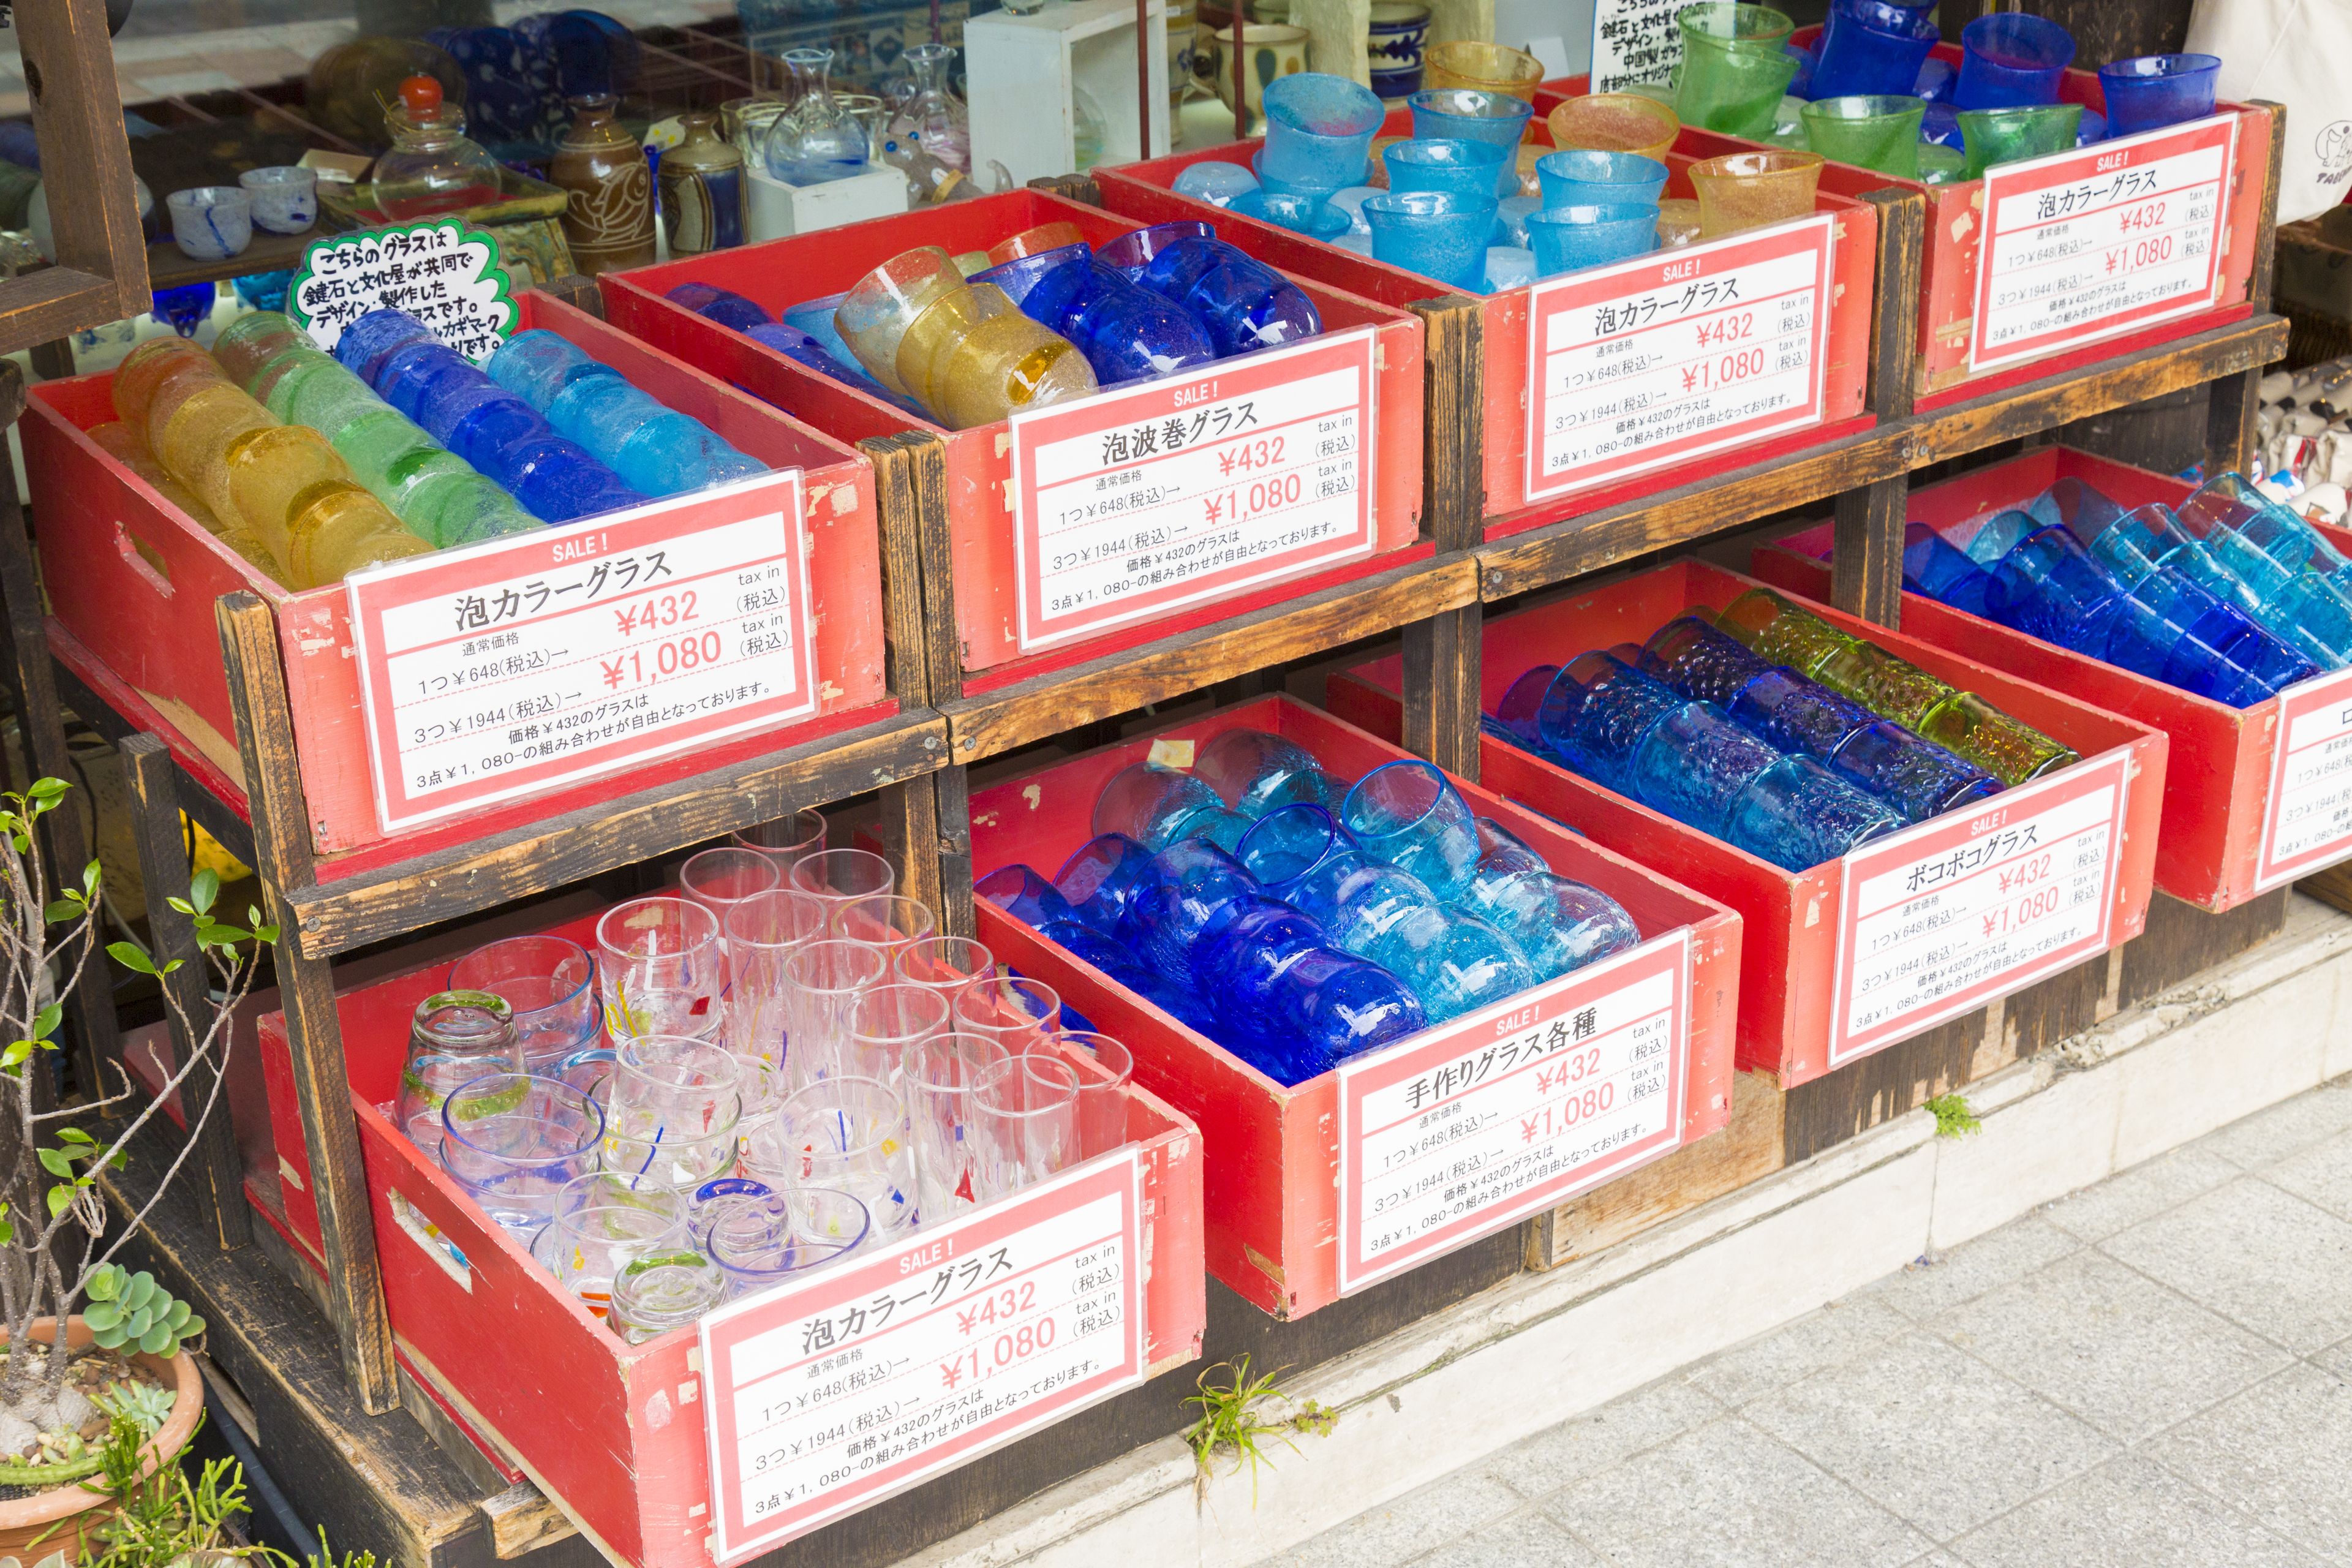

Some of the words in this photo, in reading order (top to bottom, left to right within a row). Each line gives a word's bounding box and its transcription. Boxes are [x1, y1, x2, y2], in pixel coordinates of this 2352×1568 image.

[320, 232, 447, 274] こちらのグラスは
[303, 252, 474, 307] 鍵石と文化屋が共同で
[1663, 258, 1700, 282] SALE!
[1595, 277, 1739, 337] 泡カラーグラス
[1781, 300, 1796, 311] tax
[1800, 293, 1809, 306] in
[1696, 312, 1753, 348] ¥432
[1777, 312, 1810, 333] (税込)
[1596, 339, 1633, 358] 通常価格
[1779, 341, 1794, 352] tax
[1798, 335, 1806, 347] in
[1682, 347, 1764, 393] ¥1,080
[1775, 350, 1808, 371] (税込)
[1174, 381, 1218, 407] SALE!
[1102, 401, 1258, 466] 泡波巻グラス
[1318, 421, 1337, 433] tax
[1342, 414, 1352, 427] in
[1218, 435, 1285, 477] ¥432
[1315, 434, 1355, 458] (税込)
[1096, 469, 1142, 491] 通常価格
[1318, 465, 1337, 477] tax
[1342, 458, 1352, 471] in
[1204, 473, 1301, 525] ¥1,080
[1316, 475, 1355, 498] (税込)
[552, 533, 608, 562] SALE!
[737, 572, 761, 586] tax
[767, 565, 780, 579] in
[454, 551, 672, 632] 泡カラーグラス
[737, 586, 785, 613] (税込)
[614, 590, 699, 636] ¥432
[742, 620, 765, 633] tax
[771, 612, 783, 627] in
[462, 631, 519, 657] 通常価格
[740, 630, 788, 657] (税込)
[600, 631, 721, 690] ¥1,080
[1971, 809, 2007, 836] SALE!
[2078, 836, 2092, 848] tax
[2095, 829, 2105, 840] in
[1906, 824, 2037, 892] ボコボコグラス
[2073, 846, 2105, 869] (税込)
[1999, 853, 2051, 894] ¥432
[2073, 876, 2087, 887] tax
[2091, 869, 2100, 880] in
[1902, 895, 1939, 917] 通常価格
[2069, 883, 2100, 906] (税込)
[1982, 886, 2059, 938] ¥1,080
[1496, 1005, 1539, 1036] SALE!
[1633, 1025, 1651, 1039] tax
[1656, 1017, 1665, 1030] in
[1405, 1006, 1597, 1109] 手作りグラス各種
[1629, 1035, 1667, 1063] (税込)
[1536, 1048, 1600, 1095] ¥432
[1631, 1068, 1649, 1081] tax
[1654, 1060, 1664, 1072] in
[1627, 1074, 1665, 1102] (税込)
[1419, 1102, 1462, 1129] 通常価格
[1520, 1082, 1614, 1144] ¥1,080
[900, 1238, 952, 1274] SALE!
[1075, 1253, 1097, 1268] tax
[1103, 1245, 1115, 1258] in
[1072, 1264, 1119, 1295] (税込)
[802, 1246, 1013, 1355] 泡カラーグラス
[956, 1281, 1036, 1336] ¥432
[1076, 1298, 1098, 1314] tax
[1104, 1291, 1116, 1304] in
[1073, 1305, 1120, 1338] (税込)
[807, 1348, 863, 1379] 通常価格
[939, 1317, 1055, 1389] ¥1,080
